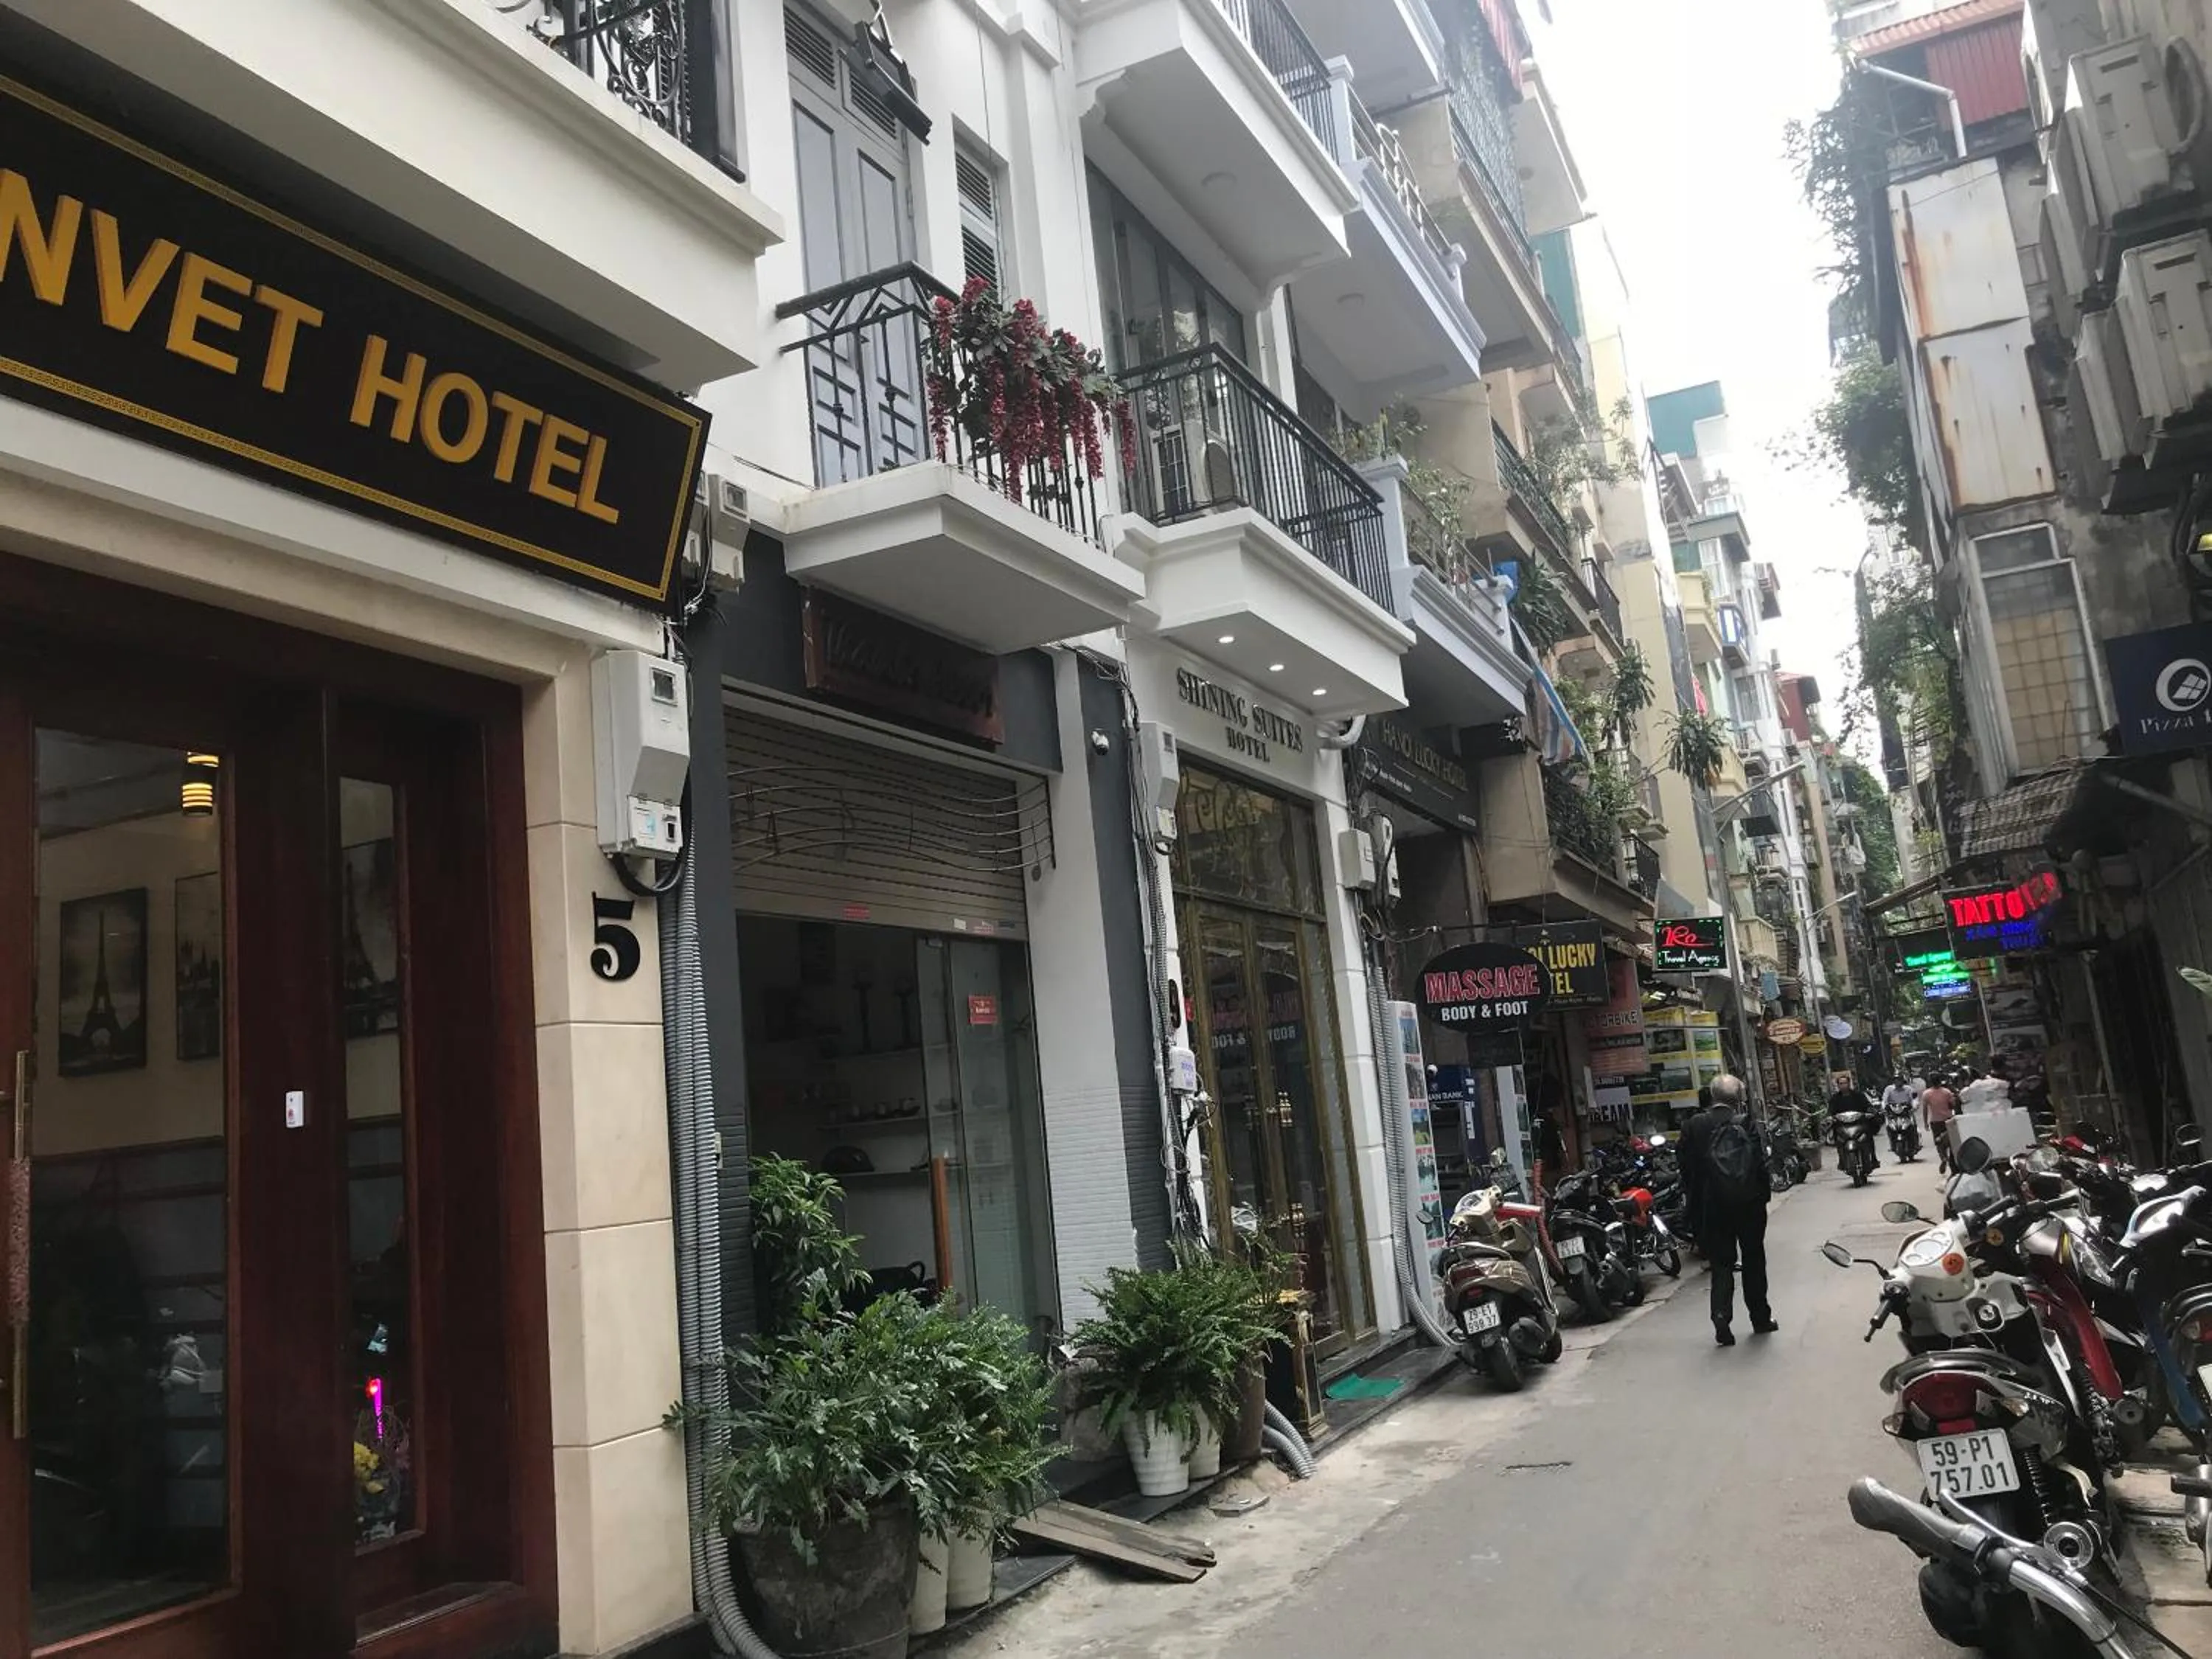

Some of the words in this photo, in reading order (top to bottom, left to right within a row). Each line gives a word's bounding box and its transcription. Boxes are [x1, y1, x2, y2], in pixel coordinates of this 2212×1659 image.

[0, 168, 323, 394] NVET
[349, 334, 620, 525] HOTEL
[1177, 667, 1248, 728] SHINING
[1252, 704, 1303, 753] SUITES
[1225, 726, 1270, 762] HOTEL
[591, 891, 641, 983] 5
[1548, 943, 1596, 970] LUCKY
[1425, 964, 1540, 1004] MASSAGE
[1441, 1005, 1476, 1021] BODY
[1481, 1004, 1491, 1018] &
[1495, 1001, 1528, 1017] FOOT
[1930, 1461, 2009, 1495] 757.01
